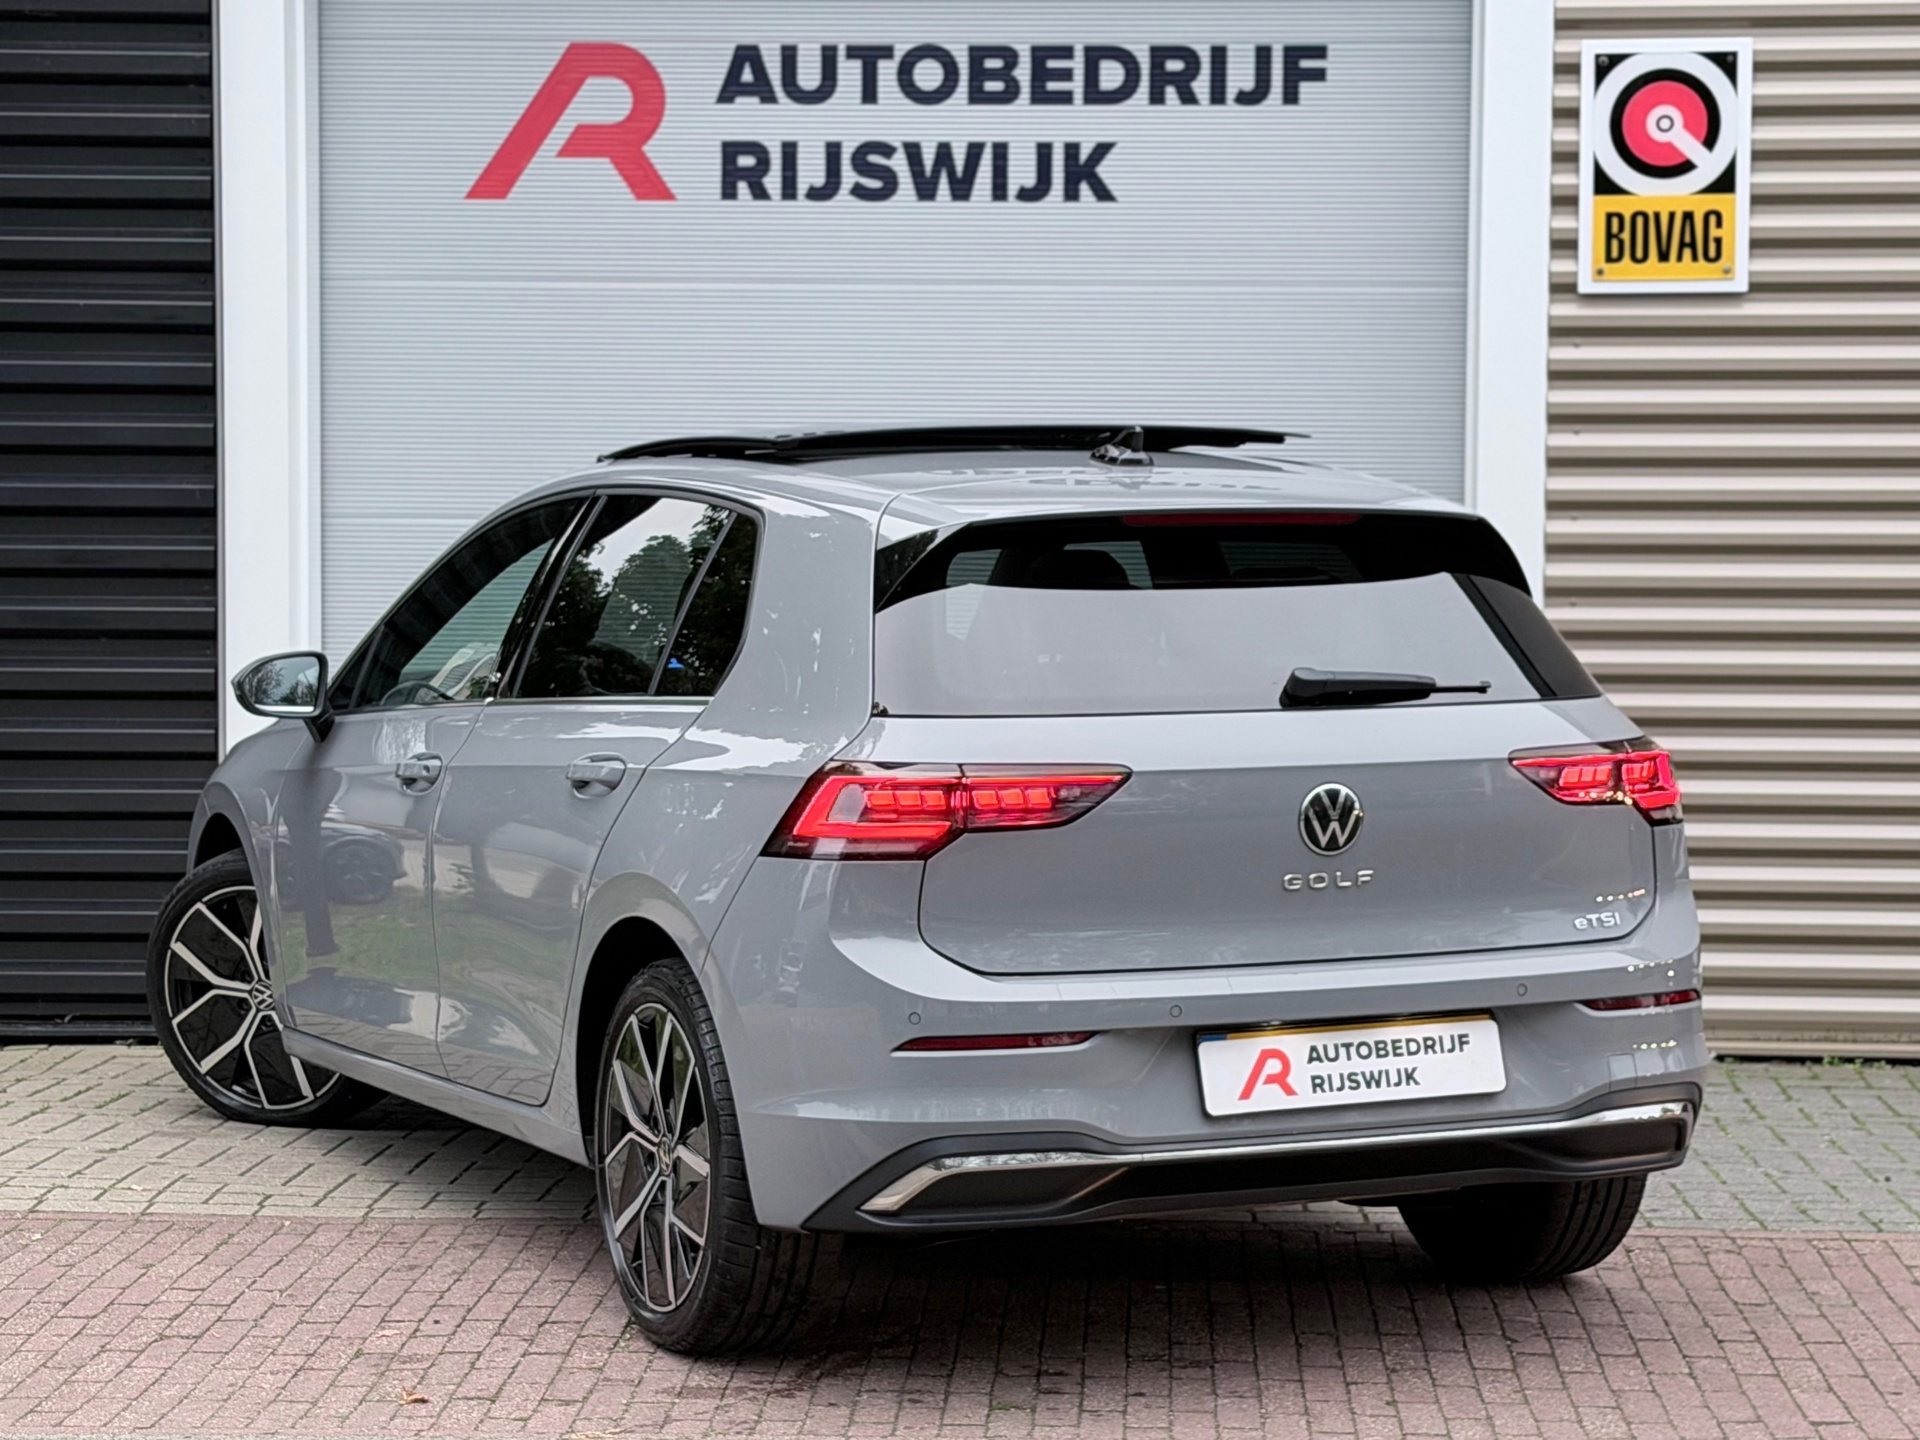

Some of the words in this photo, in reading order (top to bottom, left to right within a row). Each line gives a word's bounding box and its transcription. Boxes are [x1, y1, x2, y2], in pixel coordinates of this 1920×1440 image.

[716, 43, 1329, 106] AUTOBEDRIJF
[720, 140, 1119, 203] RIJSWIJK
[1604, 209, 1724, 265] BOVAG
[1283, 869, 1375, 890] GOLF
[1574, 911, 1621, 930] eTSI
[1306, 1033, 1471, 1065] AUTOBEDRIJF
[1310, 1066, 1421, 1095] RIJSWIJK
